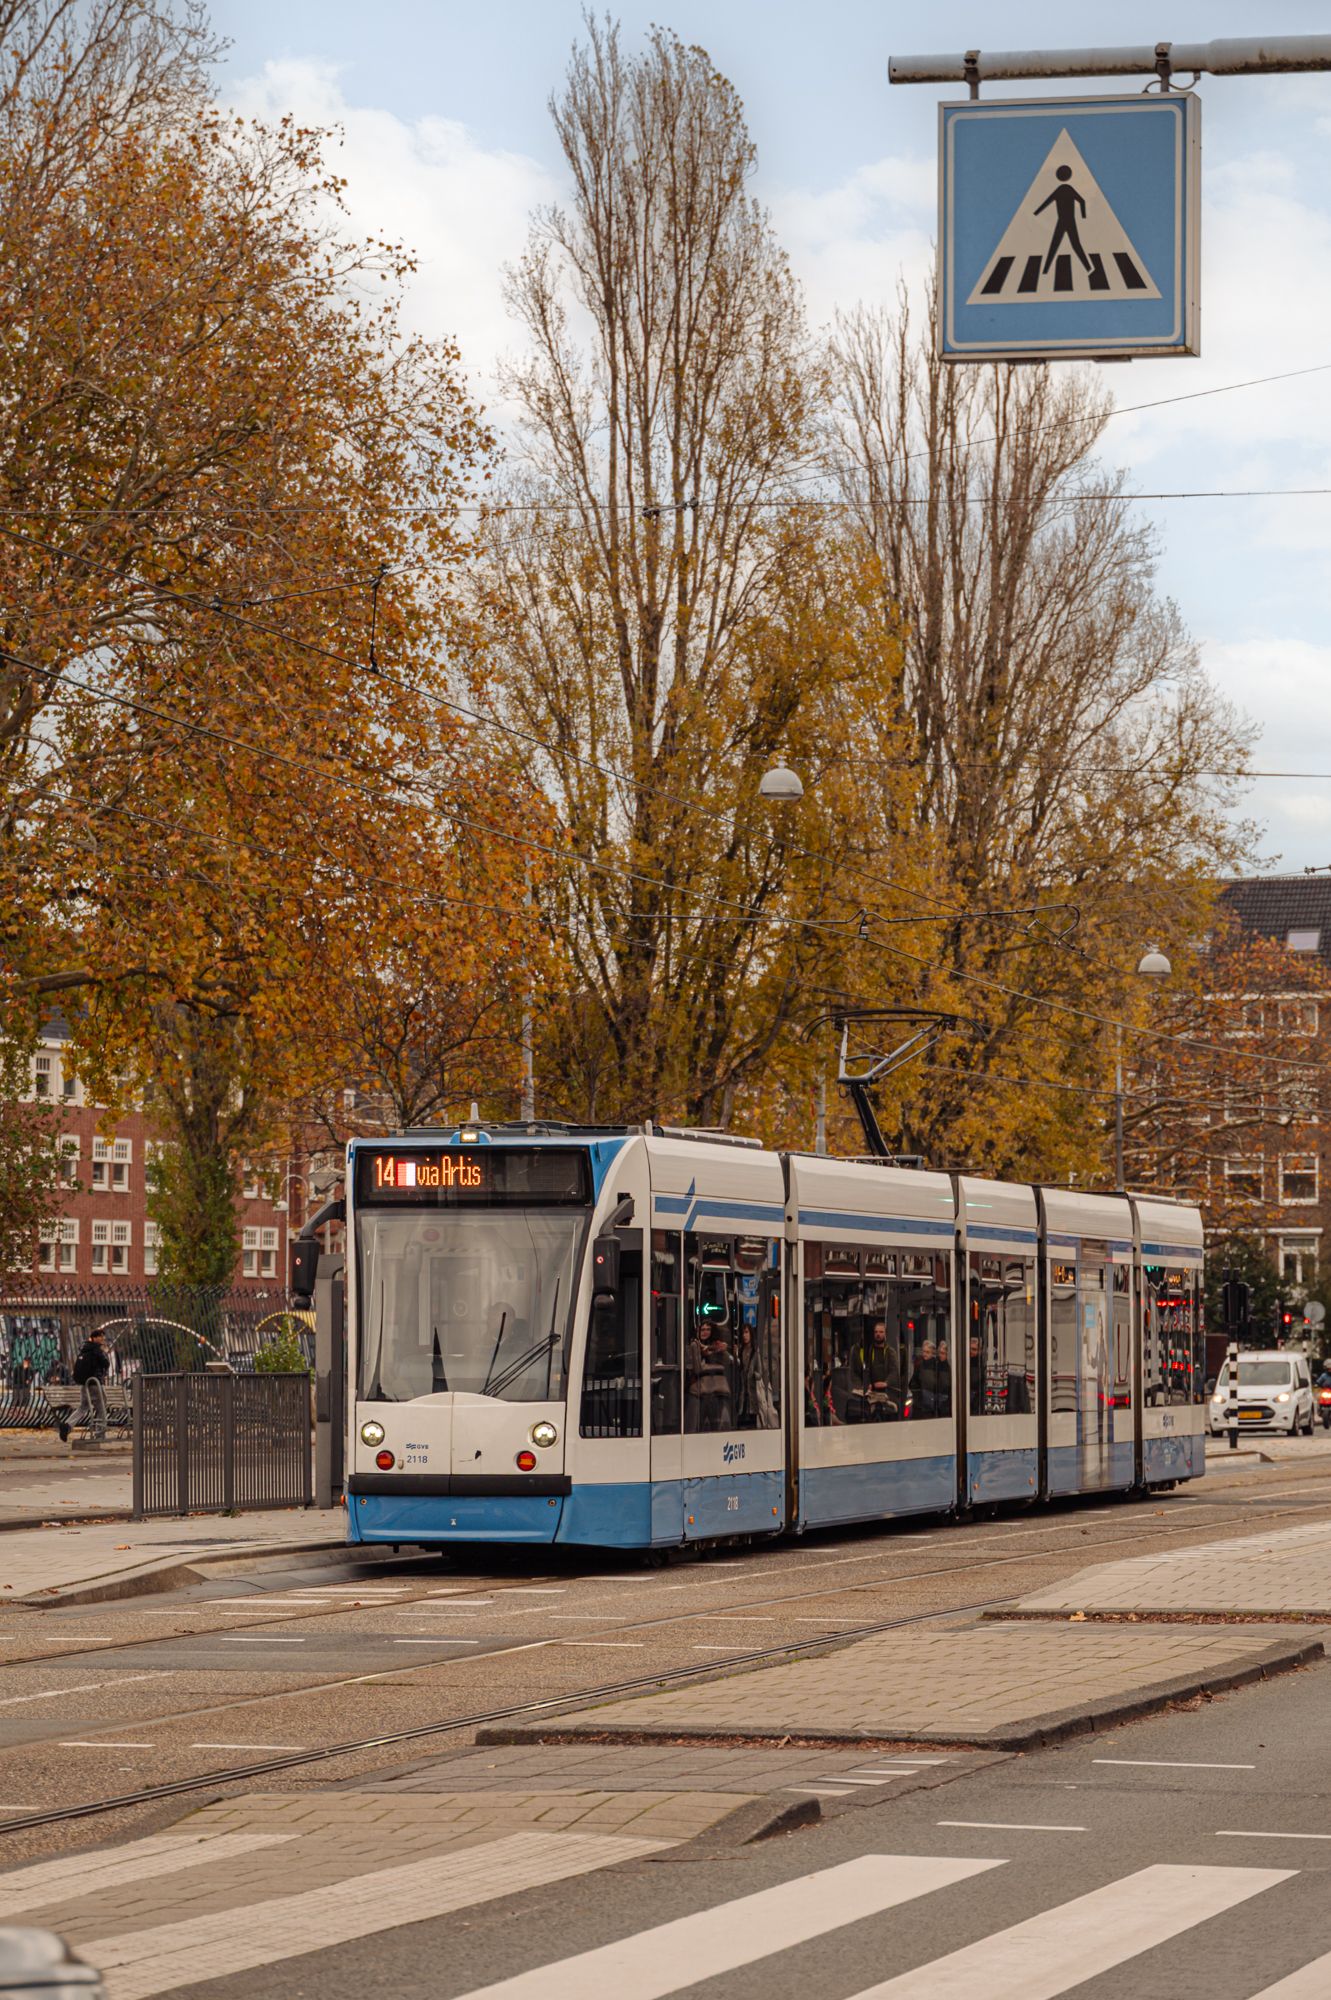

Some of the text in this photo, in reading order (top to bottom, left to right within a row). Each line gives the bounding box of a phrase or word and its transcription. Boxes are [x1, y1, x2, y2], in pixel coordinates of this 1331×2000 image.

[376, 1156, 481, 1187] 14 via Artis
[407, 1455, 428, 1464] 2118
[734, 1443, 745, 1460] GVB
